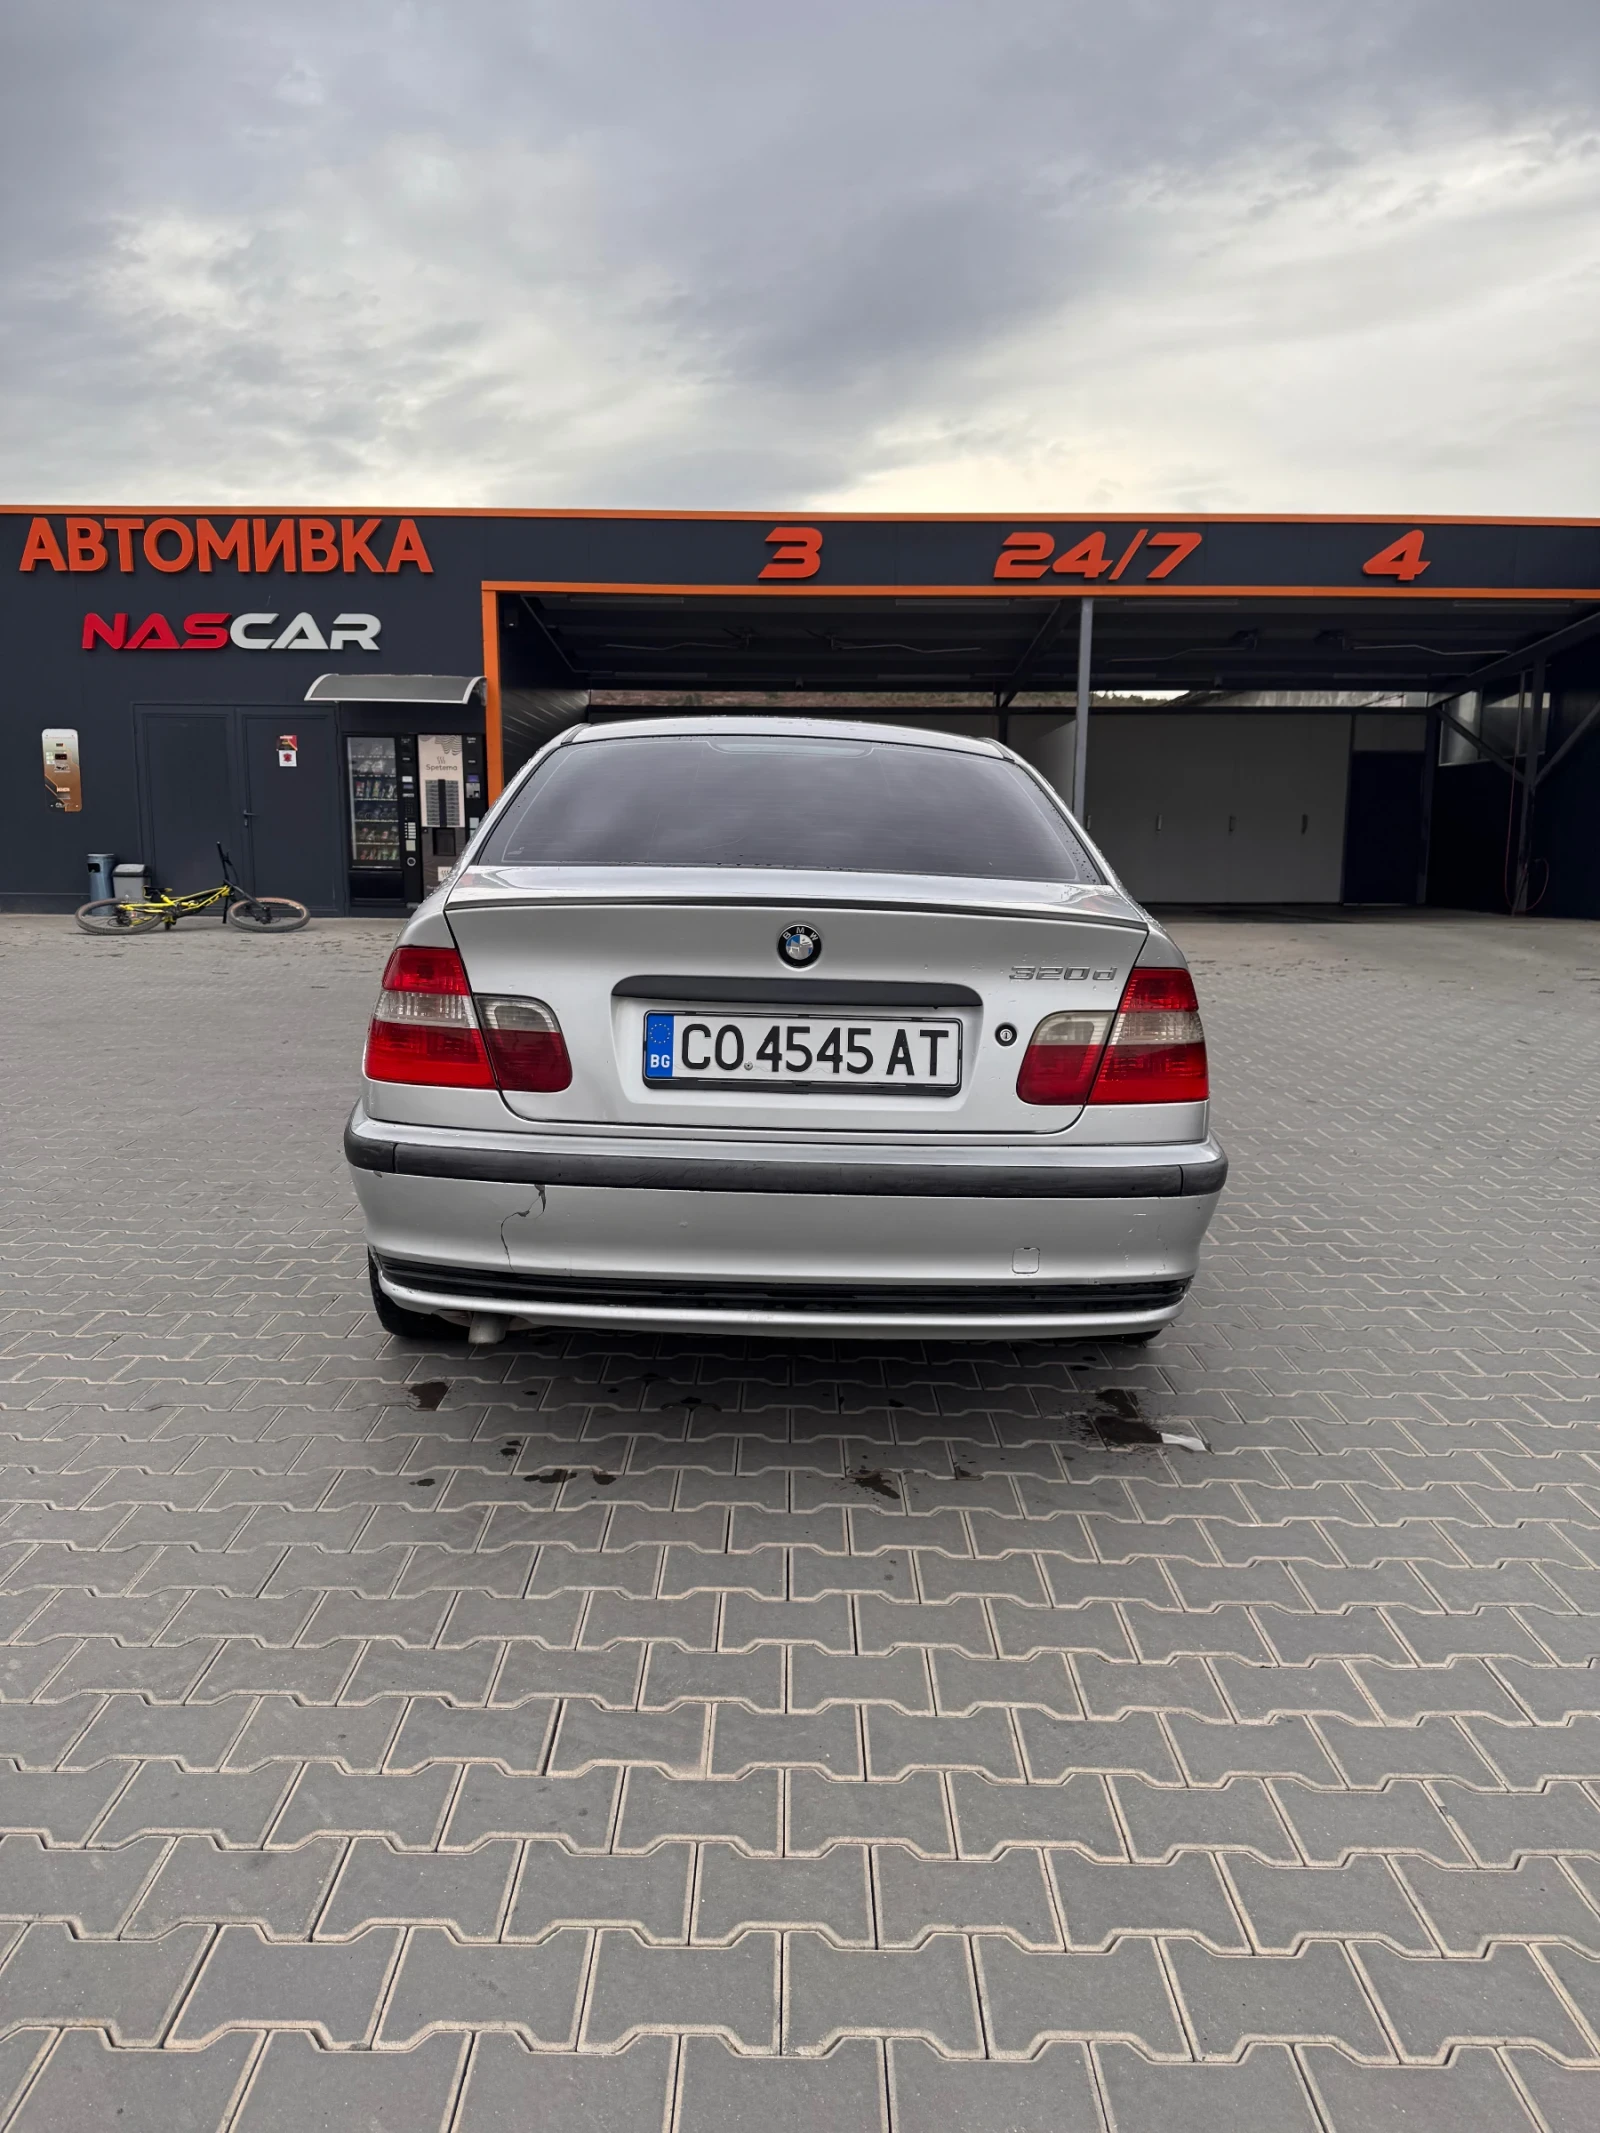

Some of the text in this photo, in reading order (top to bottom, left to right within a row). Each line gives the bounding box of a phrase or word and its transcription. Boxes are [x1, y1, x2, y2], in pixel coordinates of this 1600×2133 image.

[20, 517, 434, 573] АВТОМИВКА
[760, 528, 823, 578] 3
[994, 528, 1202, 580] 24/7
[1364, 530, 1430, 580] 4
[82, 612, 382, 650] NASCAR
[782, 926, 819, 941] BMW
[1008, 965, 1118, 981] 320d
[650, 1054, 670, 1068] BG
[756, 1025, 874, 1075] 4545
[885, 1028, 949, 1077] AT
